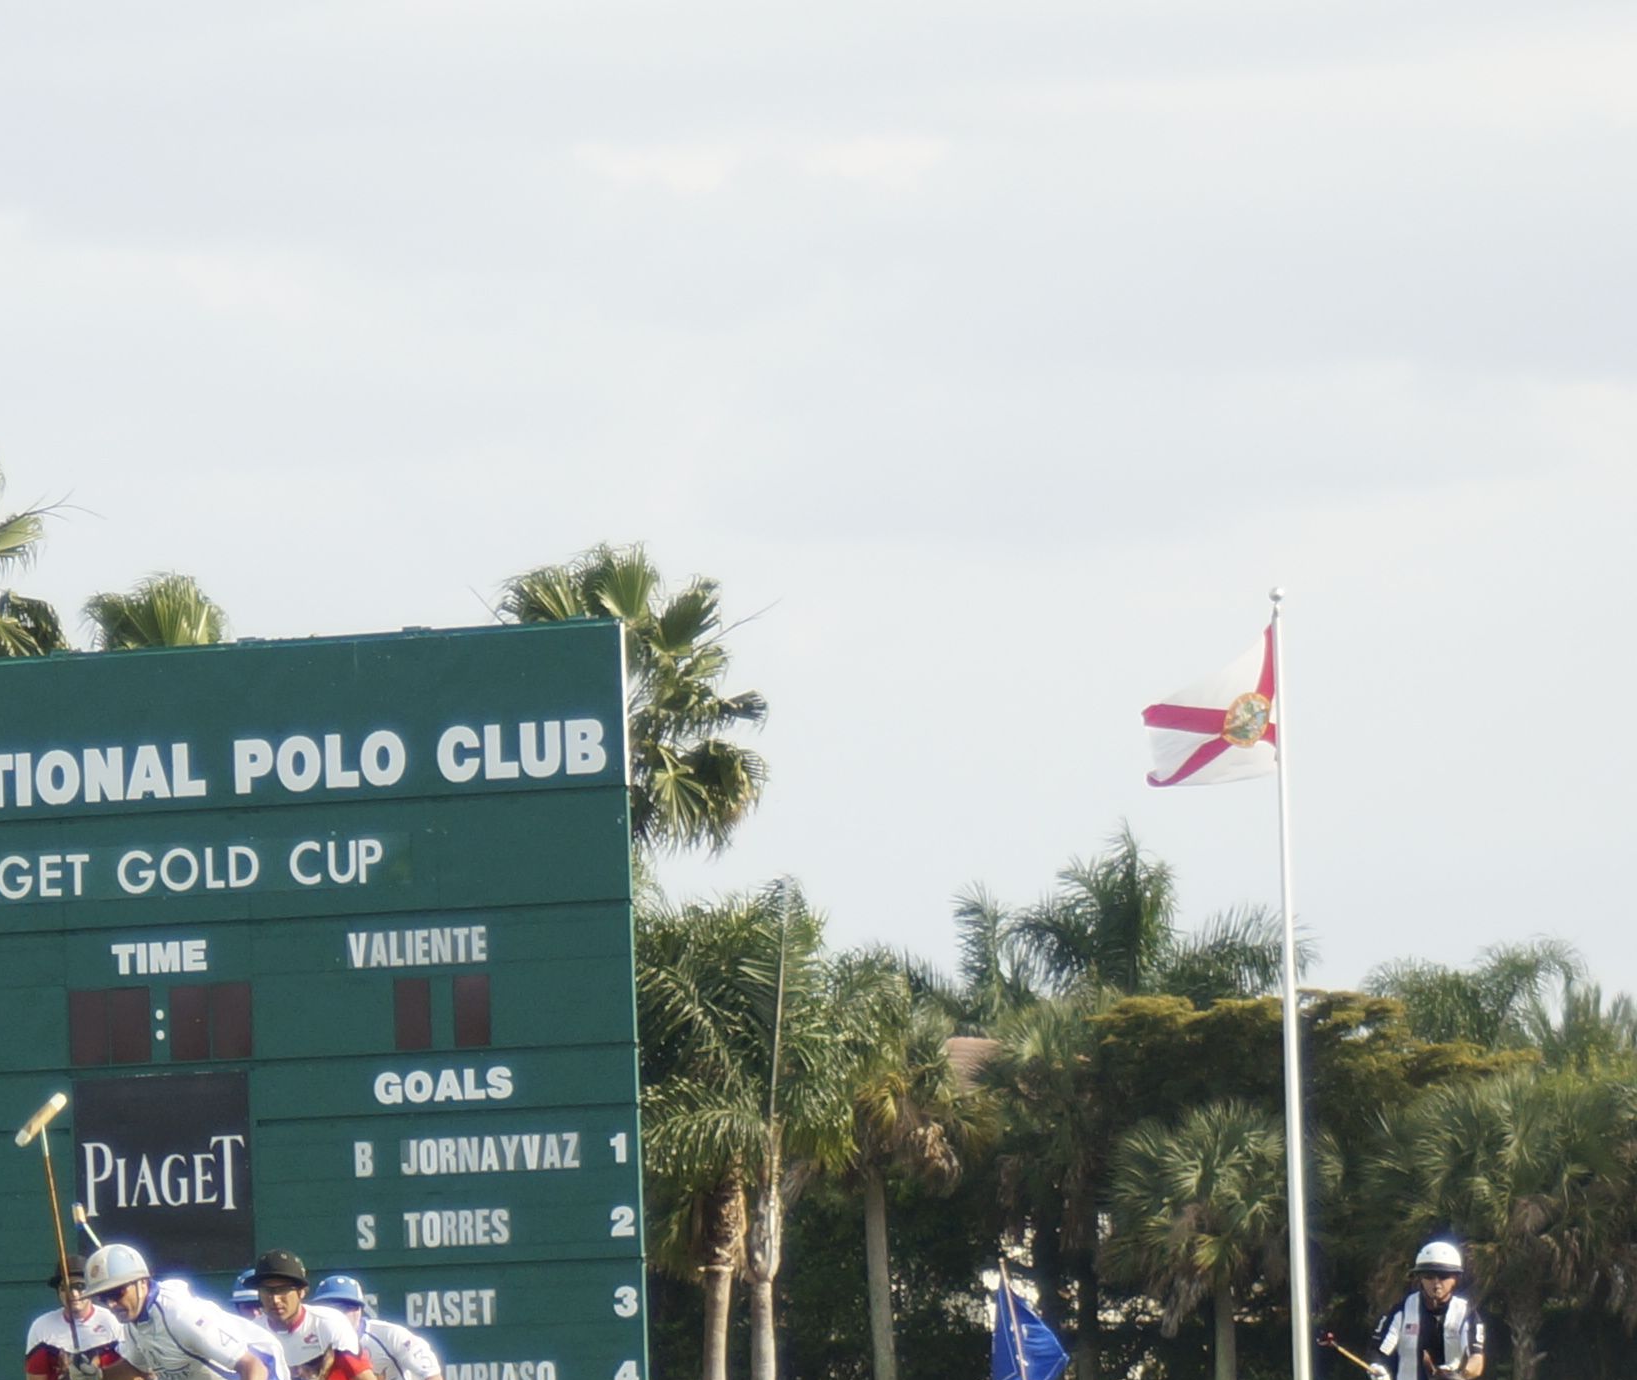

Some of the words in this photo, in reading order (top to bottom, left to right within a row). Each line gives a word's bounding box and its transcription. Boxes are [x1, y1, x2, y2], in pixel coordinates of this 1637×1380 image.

[234, 729, 406, 794] POLO
[437, 718, 606, 782] CLUB
[117, 845, 259, 894] GOLD
[290, 839, 382, 885] CUP
[112, 940, 207, 974] TIME
[348, 926, 487, 968] VALIENTE
[375, 1067, 513, 1104] GOALS
[82, 1135, 245, 1216] PIAGET
[355, 1142, 373, 1177] B
[401, 1133, 579, 1175] JORNAYVAZ
[610, 1133, 627, 1163] 1
[357, 1214, 375, 1249] S
[404, 1209, 509, 1248] TORRES
[610, 1206, 635, 1237] 2
[406, 1290, 495, 1327] CASET
[614, 1287, 638, 1317] 3
